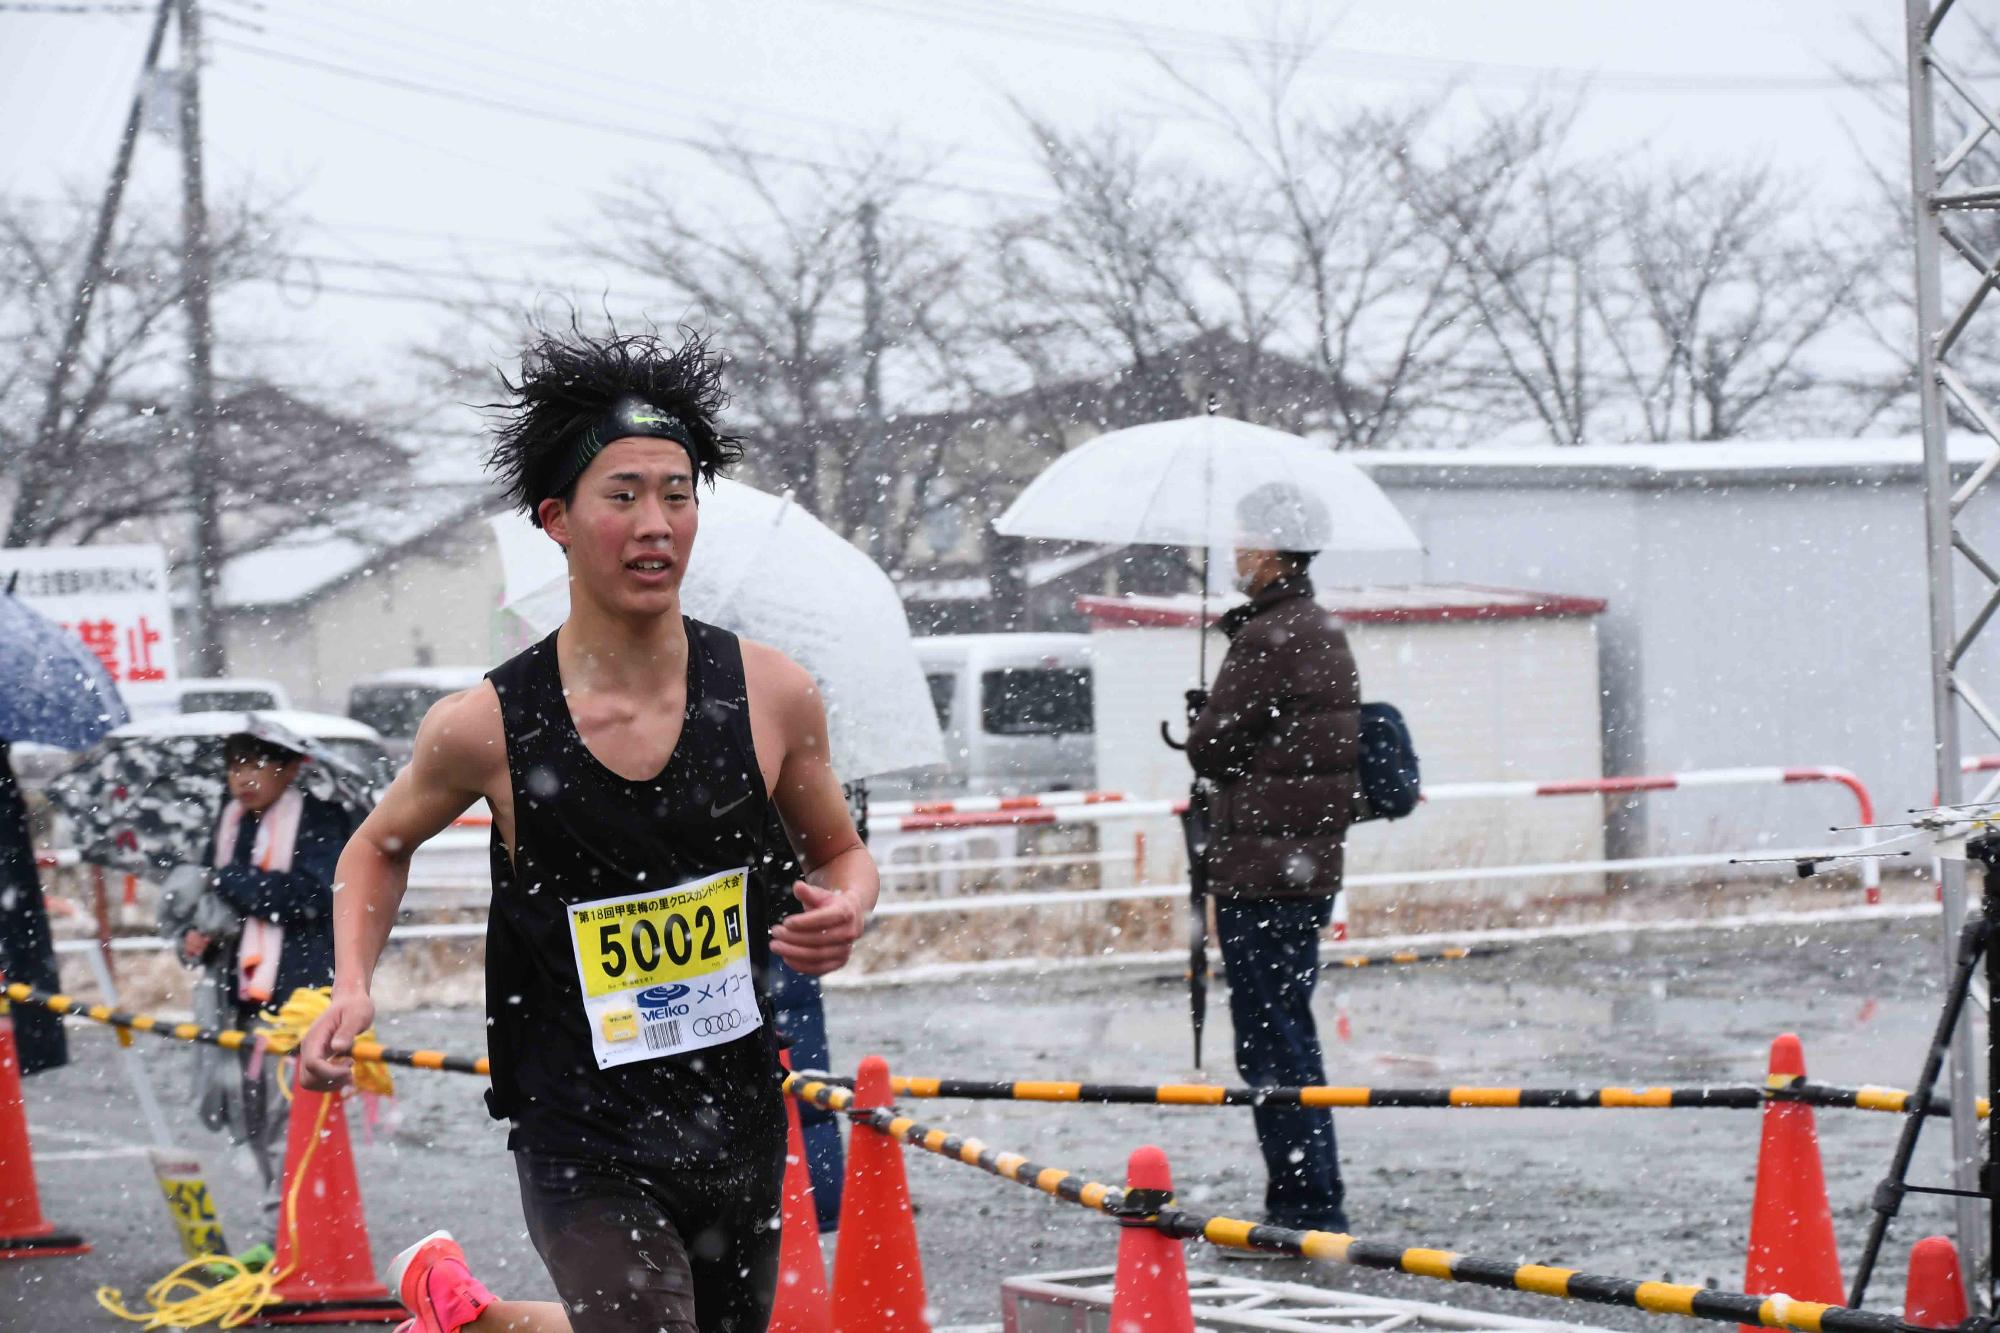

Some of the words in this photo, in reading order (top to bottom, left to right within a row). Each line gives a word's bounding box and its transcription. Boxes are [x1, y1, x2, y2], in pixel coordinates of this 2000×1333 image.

[599, 905, 721, 978] 5002
[697, 974, 748, 1004] メイコー
[641, 1003, 690, 1022] MEIKO
